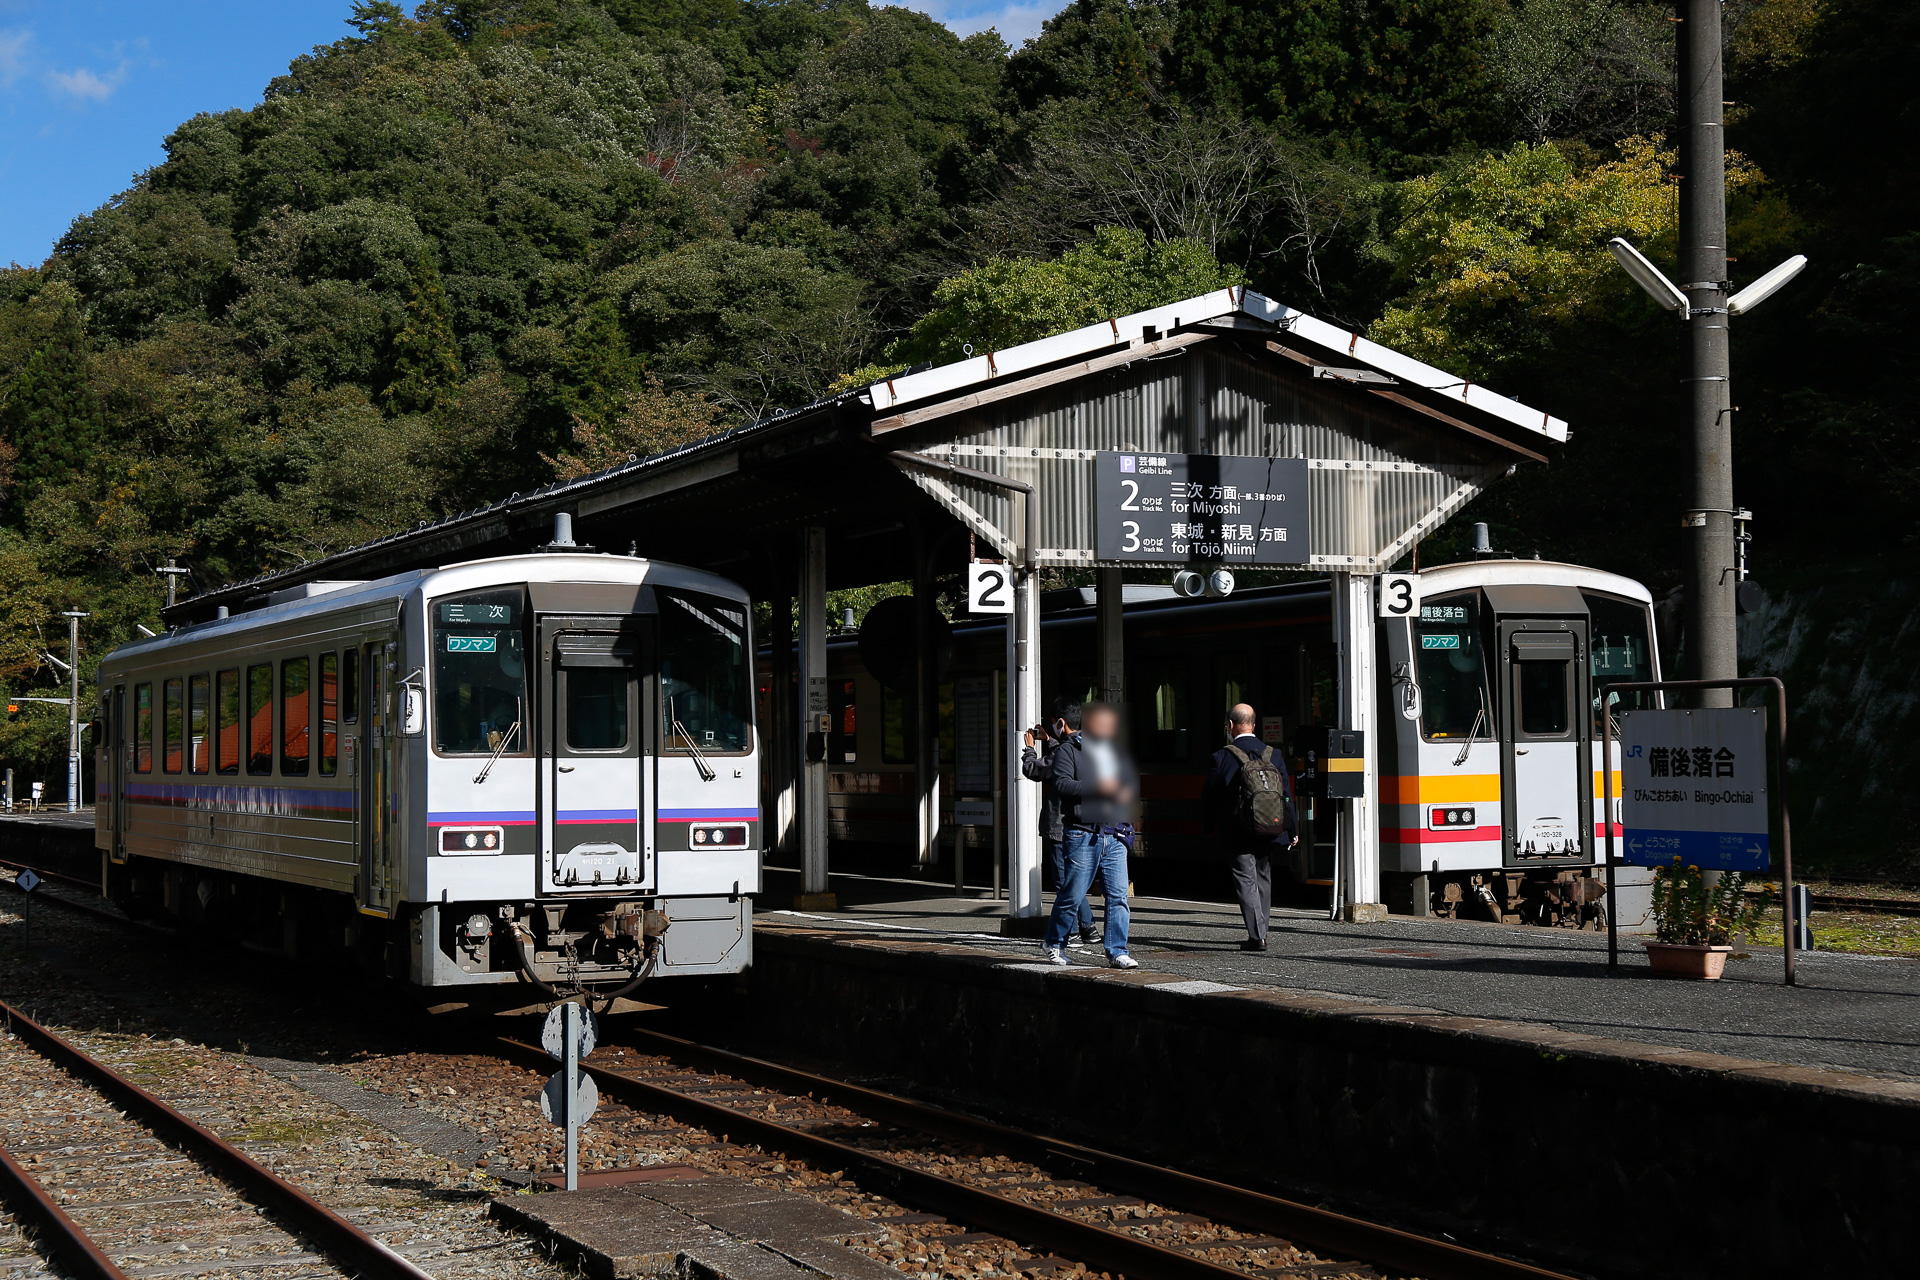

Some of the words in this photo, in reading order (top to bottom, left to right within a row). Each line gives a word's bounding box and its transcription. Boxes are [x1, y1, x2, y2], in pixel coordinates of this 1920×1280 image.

[1124, 458, 1133, 471] P
[1138, 456, 1167, 467] 芸備線
[1138, 467, 1157, 475] Geibi
[1158, 467, 1173, 476] Line
[1120, 479, 1140, 512] 2
[1169, 481, 1204, 499] 三次
[1209, 485, 1238, 500] 方面
[1141, 497, 1163, 506] のりば
[1170, 499, 1190, 513] for
[1192, 501, 1241, 517] Miyoshi
[1121, 520, 1141, 553] 3
[1259, 527, 1288, 542] 方面
[1142, 538, 1164, 547] のりば
[1170, 540, 1191, 554] for
[977, 569, 1006, 607] 2
[1387, 578, 1413, 615] 3
[1421, 606, 1465, 618] 備後落合
[449, 638, 495, 651] ワンマン
[1423, 637, 1458, 647] ワンマン
[1627, 745, 1642, 758] JR
[1648, 746, 1736, 778] 備後落合
[1634, 789, 1688, 802] びんごおちあい
[1694, 790, 1754, 805] Bingo-Ochiai
[1645, 836, 1681, 848] どうごやま
[25, 874, 31, 886] 1
